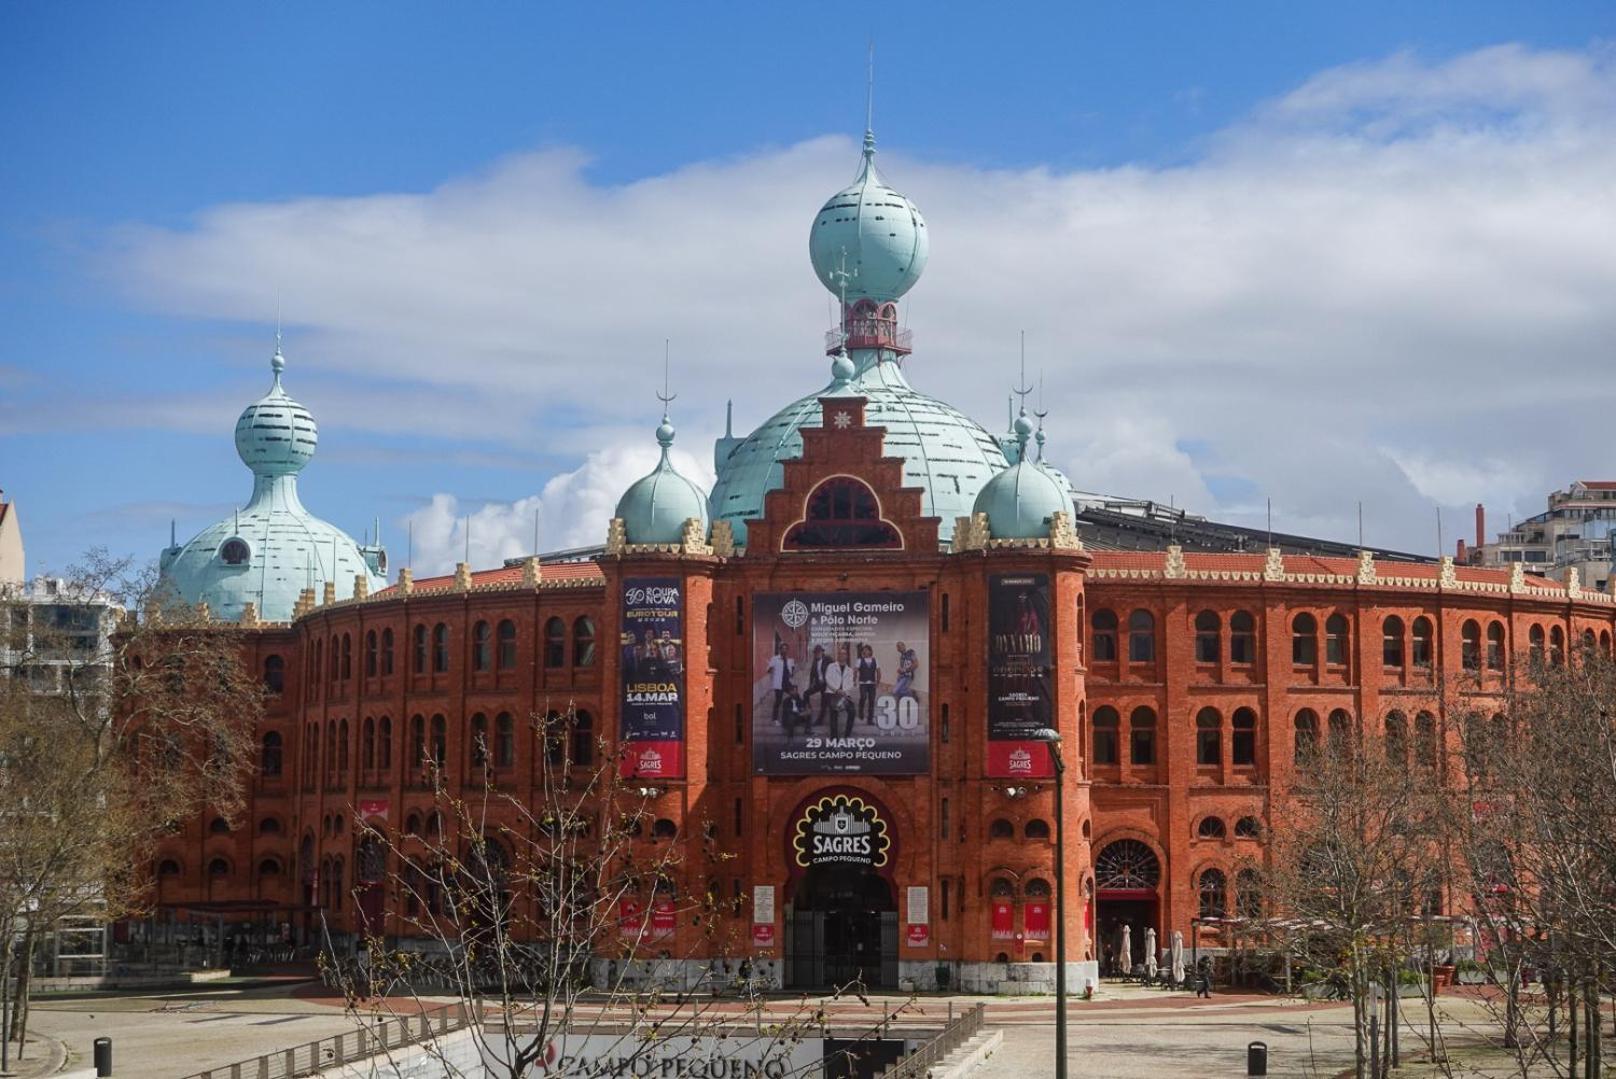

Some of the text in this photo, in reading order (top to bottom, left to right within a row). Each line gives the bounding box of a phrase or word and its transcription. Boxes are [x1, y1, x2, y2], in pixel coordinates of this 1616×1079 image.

[645, 586, 680, 597] ROUPA
[645, 594, 677, 605] NOVA
[810, 601, 905, 615] Miguel Gameiro
[626, 610, 679, 618] EUROTOUR
[811, 614, 879, 625] & Pólo Norte
[626, 682, 677, 693] LISBOA
[626, 692, 679, 703] 14.MAR
[643, 711, 656, 720] bol
[876, 695, 919, 730] 30
[805, 737, 876, 751] 29 MARÇO
[780, 751, 902, 760] SAGRES CAMPO PEQUENO
[639, 759, 662, 770] SAGRES
[1008, 759, 1032, 770] SAGRES
[812, 834, 871, 855] SAGRES
[812, 855, 872, 864] CAMPO PEQUENO
[557, 1055, 651, 1078] CAMPO
